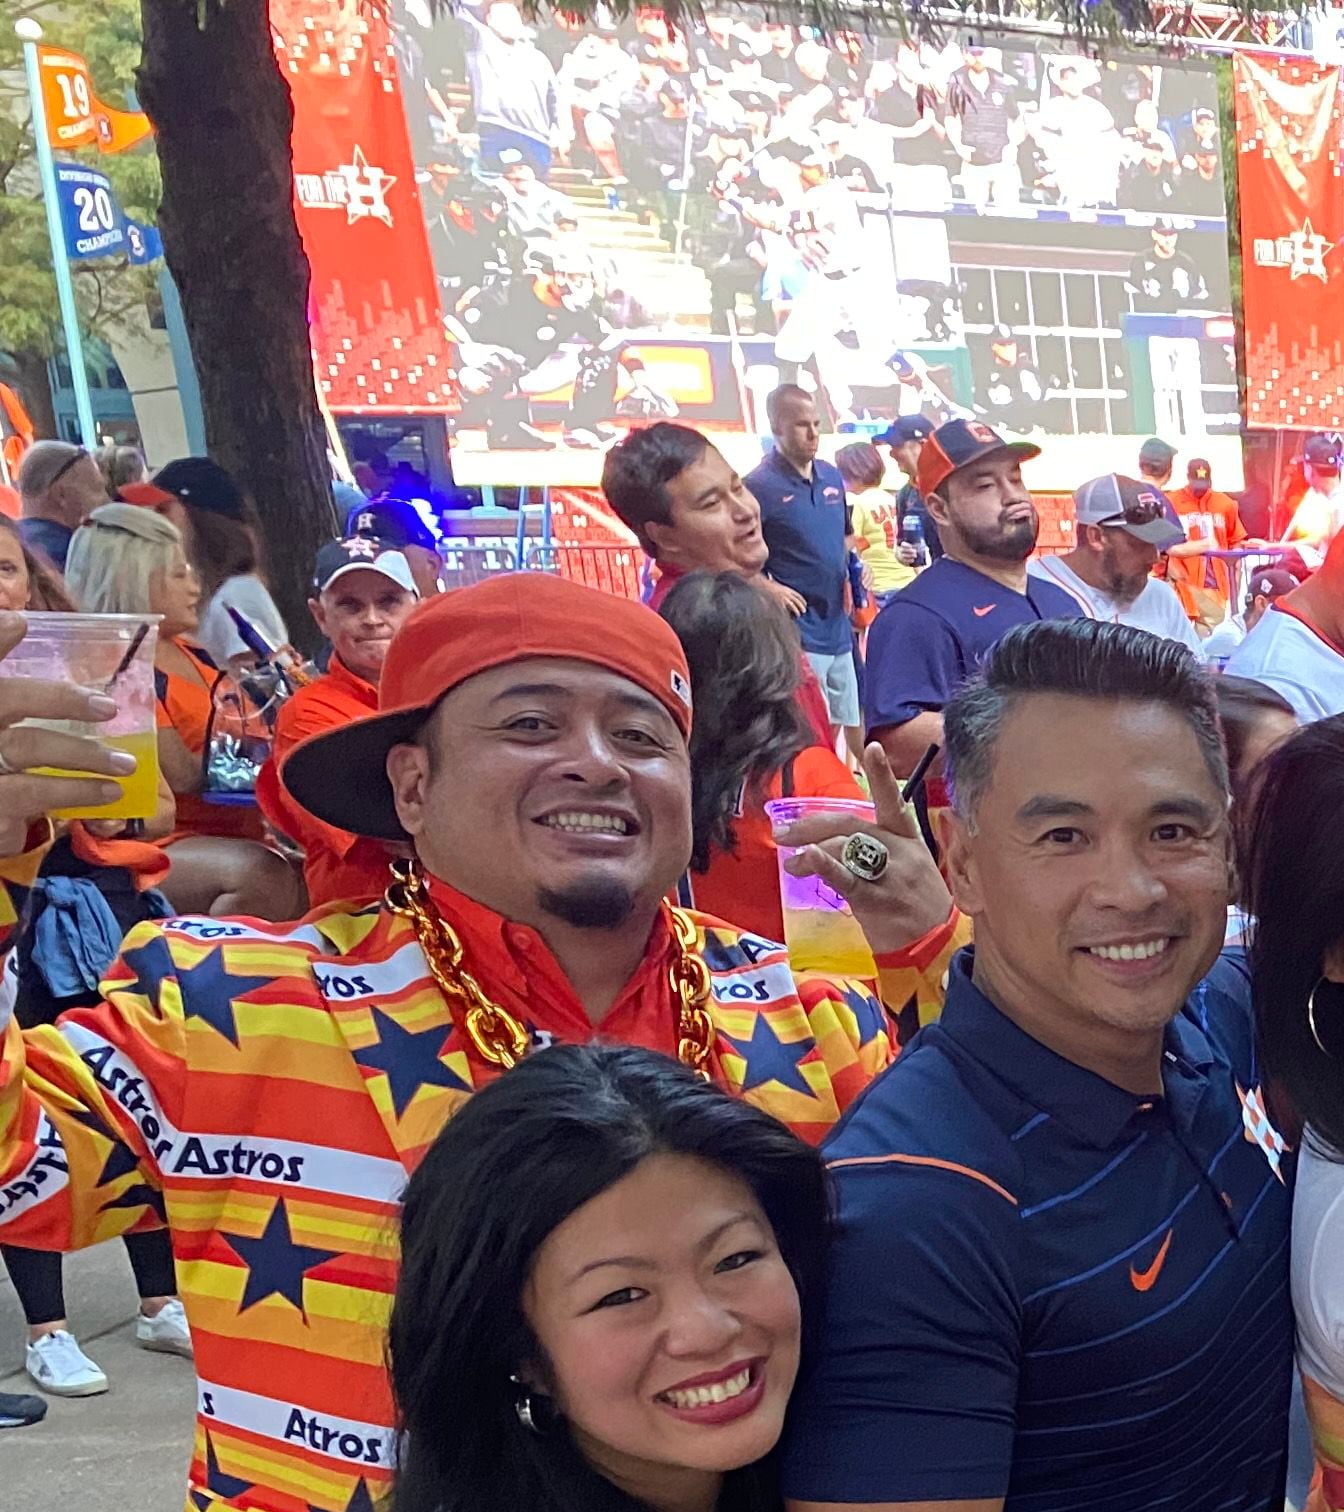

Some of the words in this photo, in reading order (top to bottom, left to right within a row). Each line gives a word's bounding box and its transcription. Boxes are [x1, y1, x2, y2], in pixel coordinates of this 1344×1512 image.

[55, 73, 90, 118] 19
[73, 187, 114, 232] 20
[314, 974, 375, 998] ros
[713, 979, 770, 1001] ros
[172, 1136, 305, 1183] Astros
[283, 1408, 383, 1464] Atros
